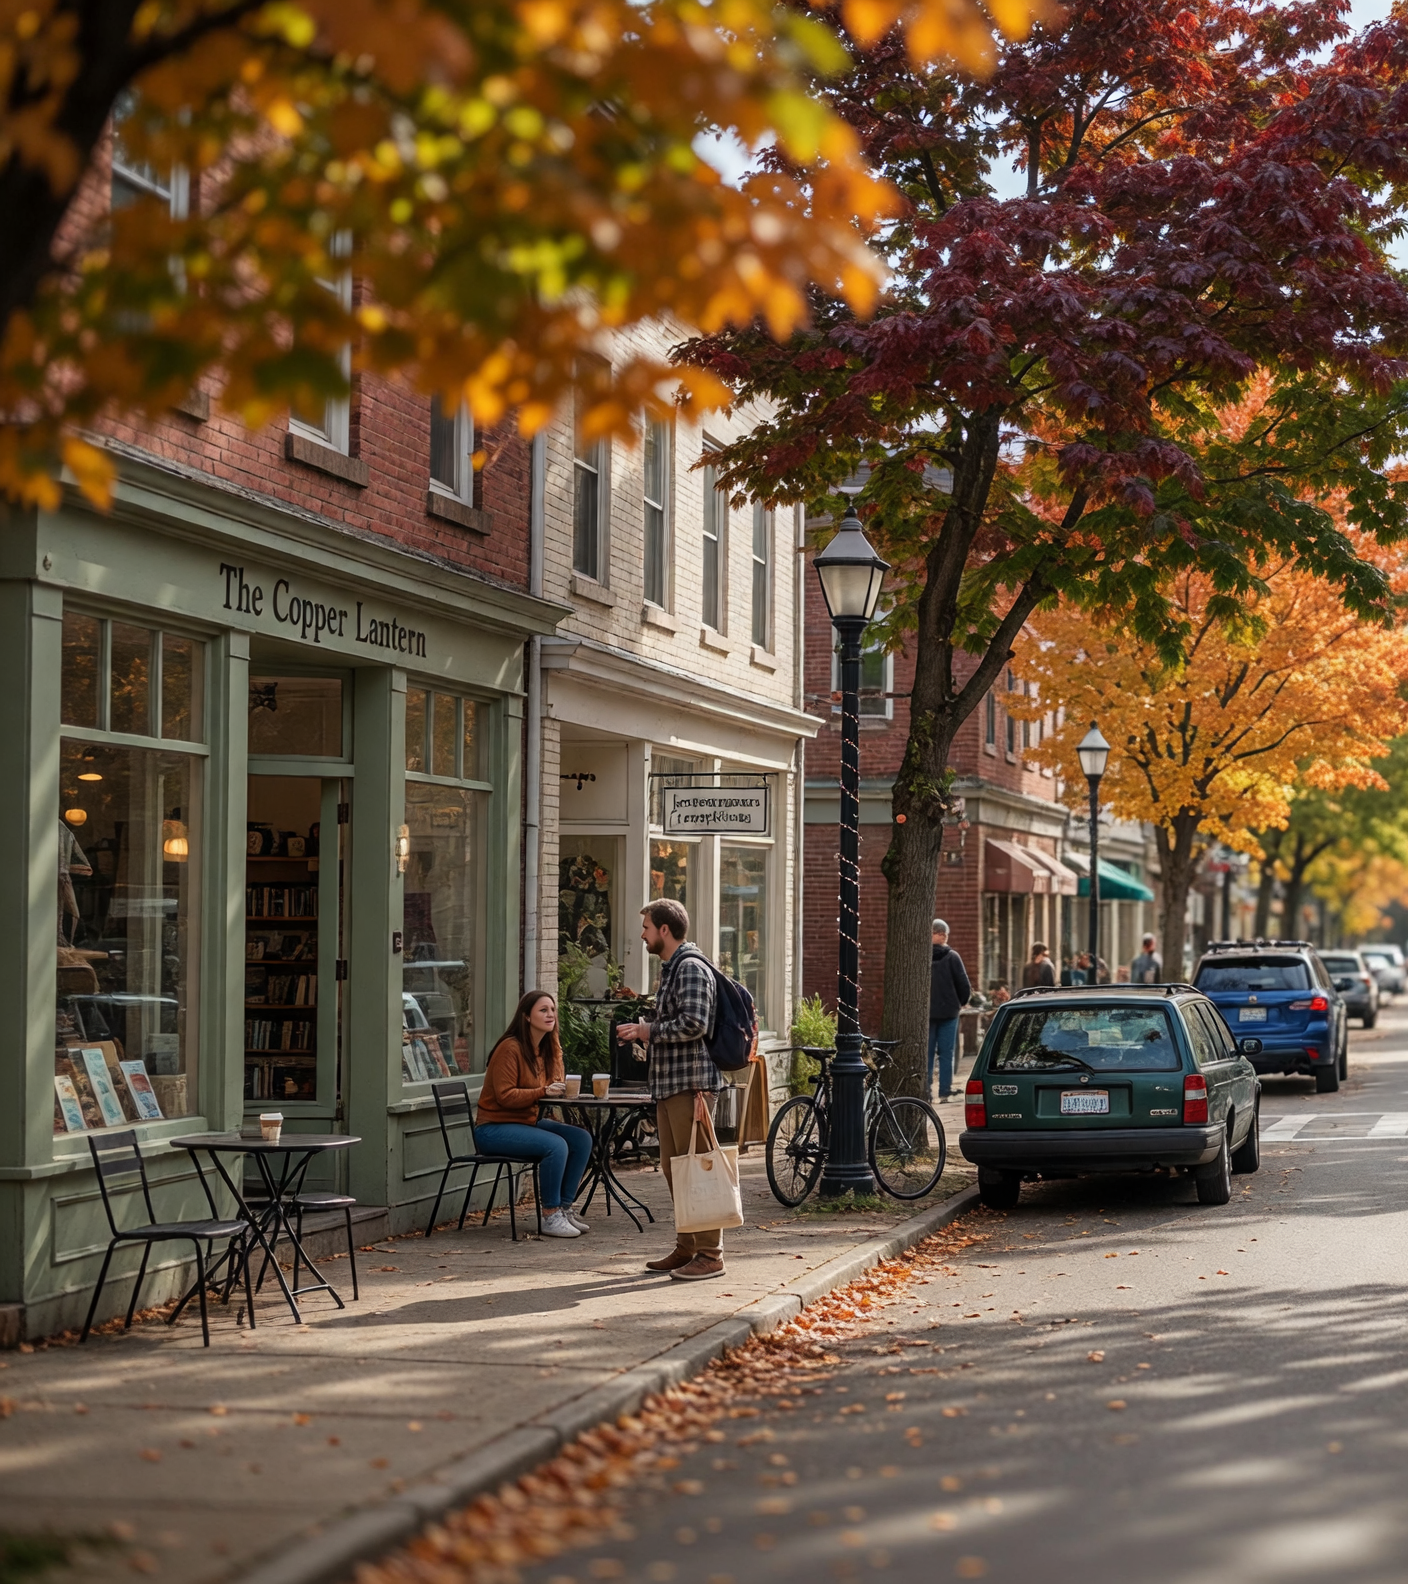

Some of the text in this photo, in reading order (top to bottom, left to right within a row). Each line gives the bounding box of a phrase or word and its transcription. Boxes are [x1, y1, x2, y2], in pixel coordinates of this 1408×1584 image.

[219, 562, 427, 658] The Copper Lantern
